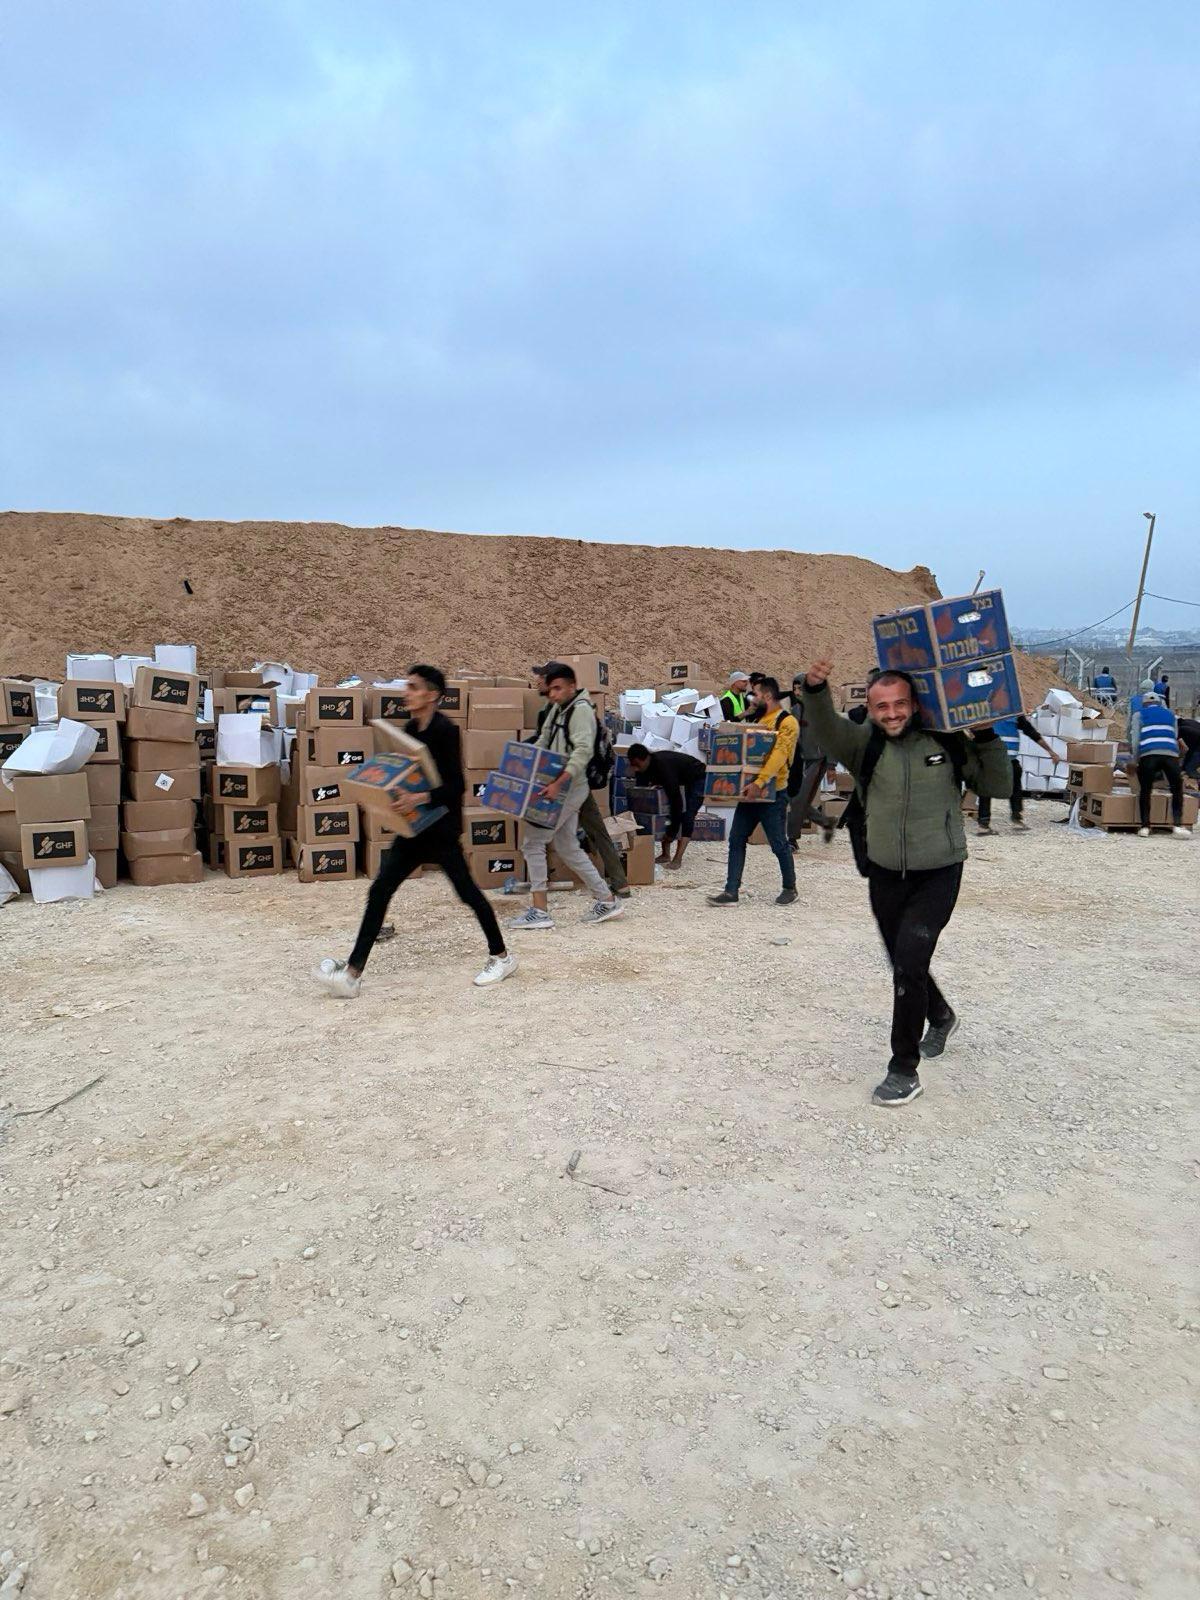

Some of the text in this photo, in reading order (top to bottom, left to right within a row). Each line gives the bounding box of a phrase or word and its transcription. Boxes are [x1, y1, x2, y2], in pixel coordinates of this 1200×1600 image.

[171, 689, 187, 697] GHF
[55, 841, 74, 849] GHF
[330, 858, 345, 866] GHF
